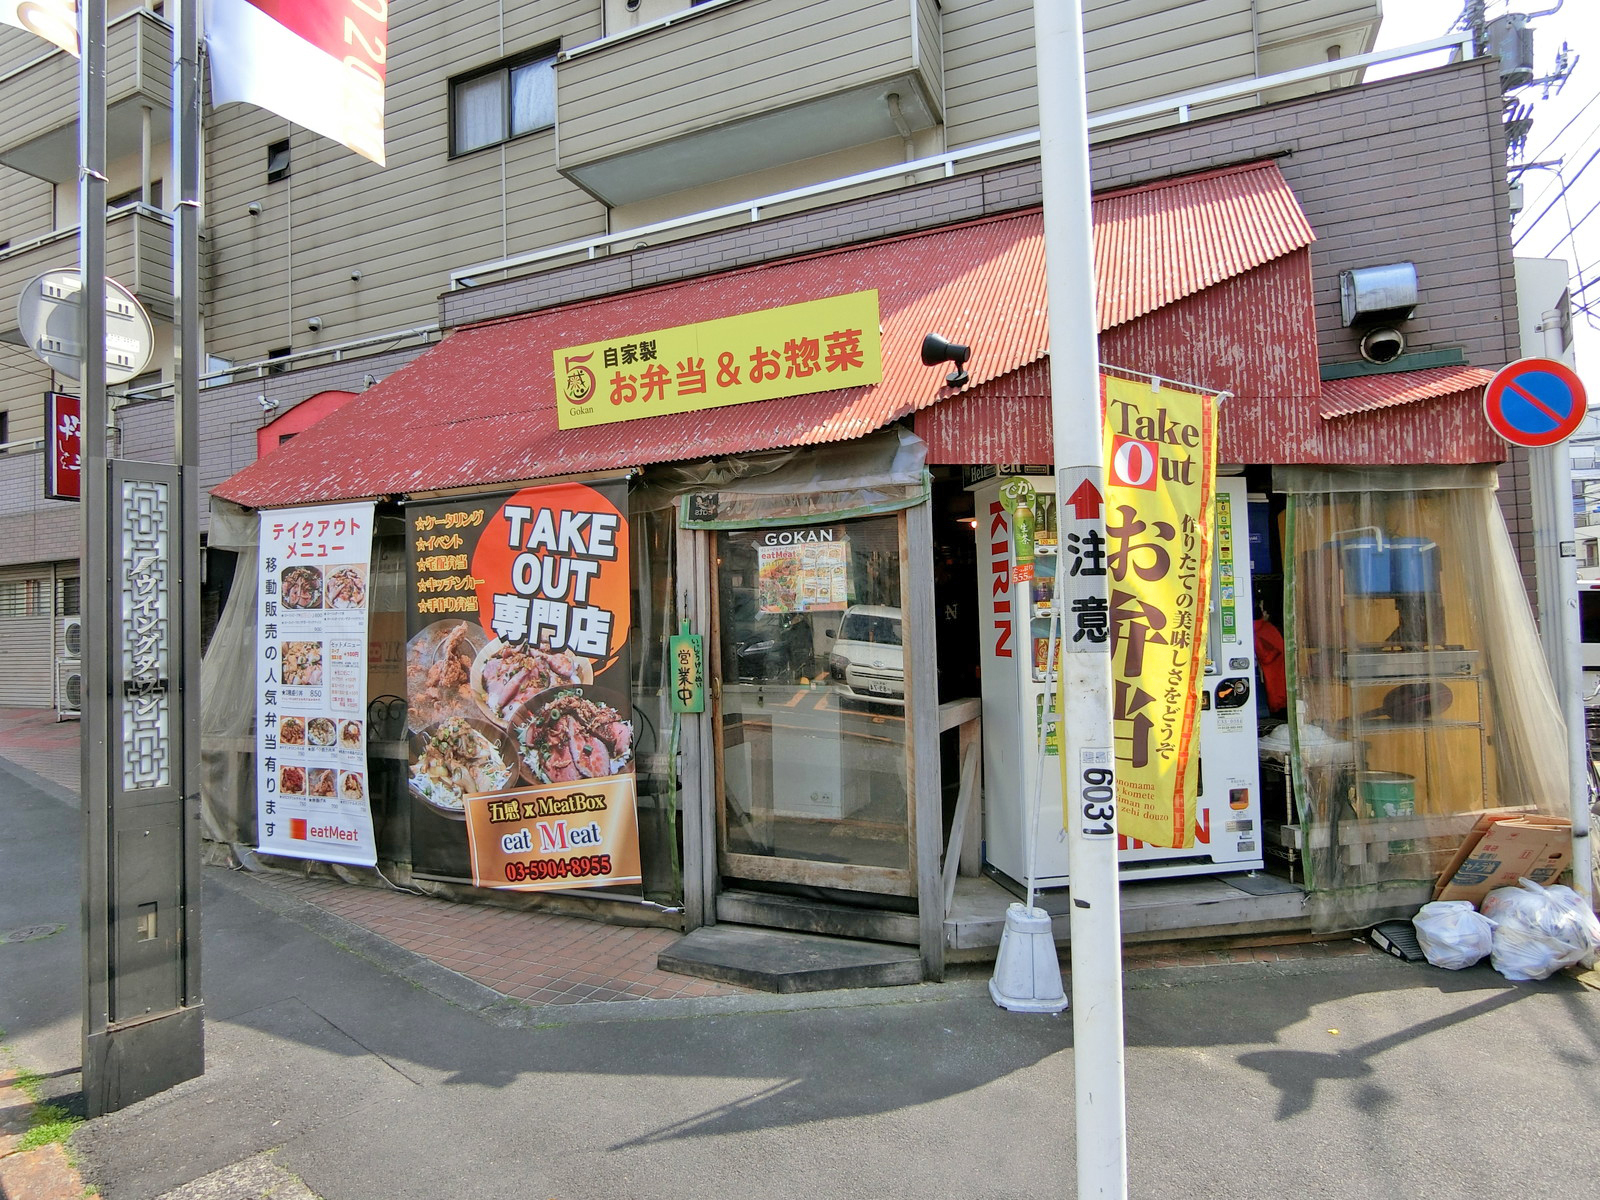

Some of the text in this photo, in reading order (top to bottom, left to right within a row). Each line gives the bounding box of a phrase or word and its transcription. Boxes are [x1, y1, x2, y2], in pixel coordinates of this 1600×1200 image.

[603, 339, 658, 369] 自家製
[569, 405, 594, 417] Gokan
[1110, 399, 1200, 448] Take
[1113, 441, 1197, 486] Out
[272, 517, 361, 541] テイクアウト
[504, 505, 619, 559] TAKE
[764, 529, 833, 546] GOKAN
[1018, 522, 1031, 545] 生茶
[286, 542, 345, 559] メニュー
[761, 551, 796, 560] eatMeat
[512, 552, 600, 602] OUT
[989, 500, 1013, 659] KIRIN
[1068, 529, 1110, 644] 注意
[491, 594, 612, 657] 専門店
[1155, 514, 1196, 760] 作りたての美味しさをどうぞ
[132, 575, 160, 715] ウイングタウン
[677, 650, 694, 707] 営業中
[264, 557, 278, 837] 移動販売の人気弁当有ります
[309, 689, 322, 698] 850
[1083, 767, 1115, 835] 6031
[1116, 795, 1155, 811] iman no
[1122, 787, 1155, 800] komete
[488, 800, 519, 822] 五感
[538, 794, 607, 816] MeatBox
[1120, 806, 1169, 822] zehi douzo
[310, 824, 359, 842] eatMeat
[503, 828, 531, 851] eat
[506, 855, 611, 881] 03-5904-8955
